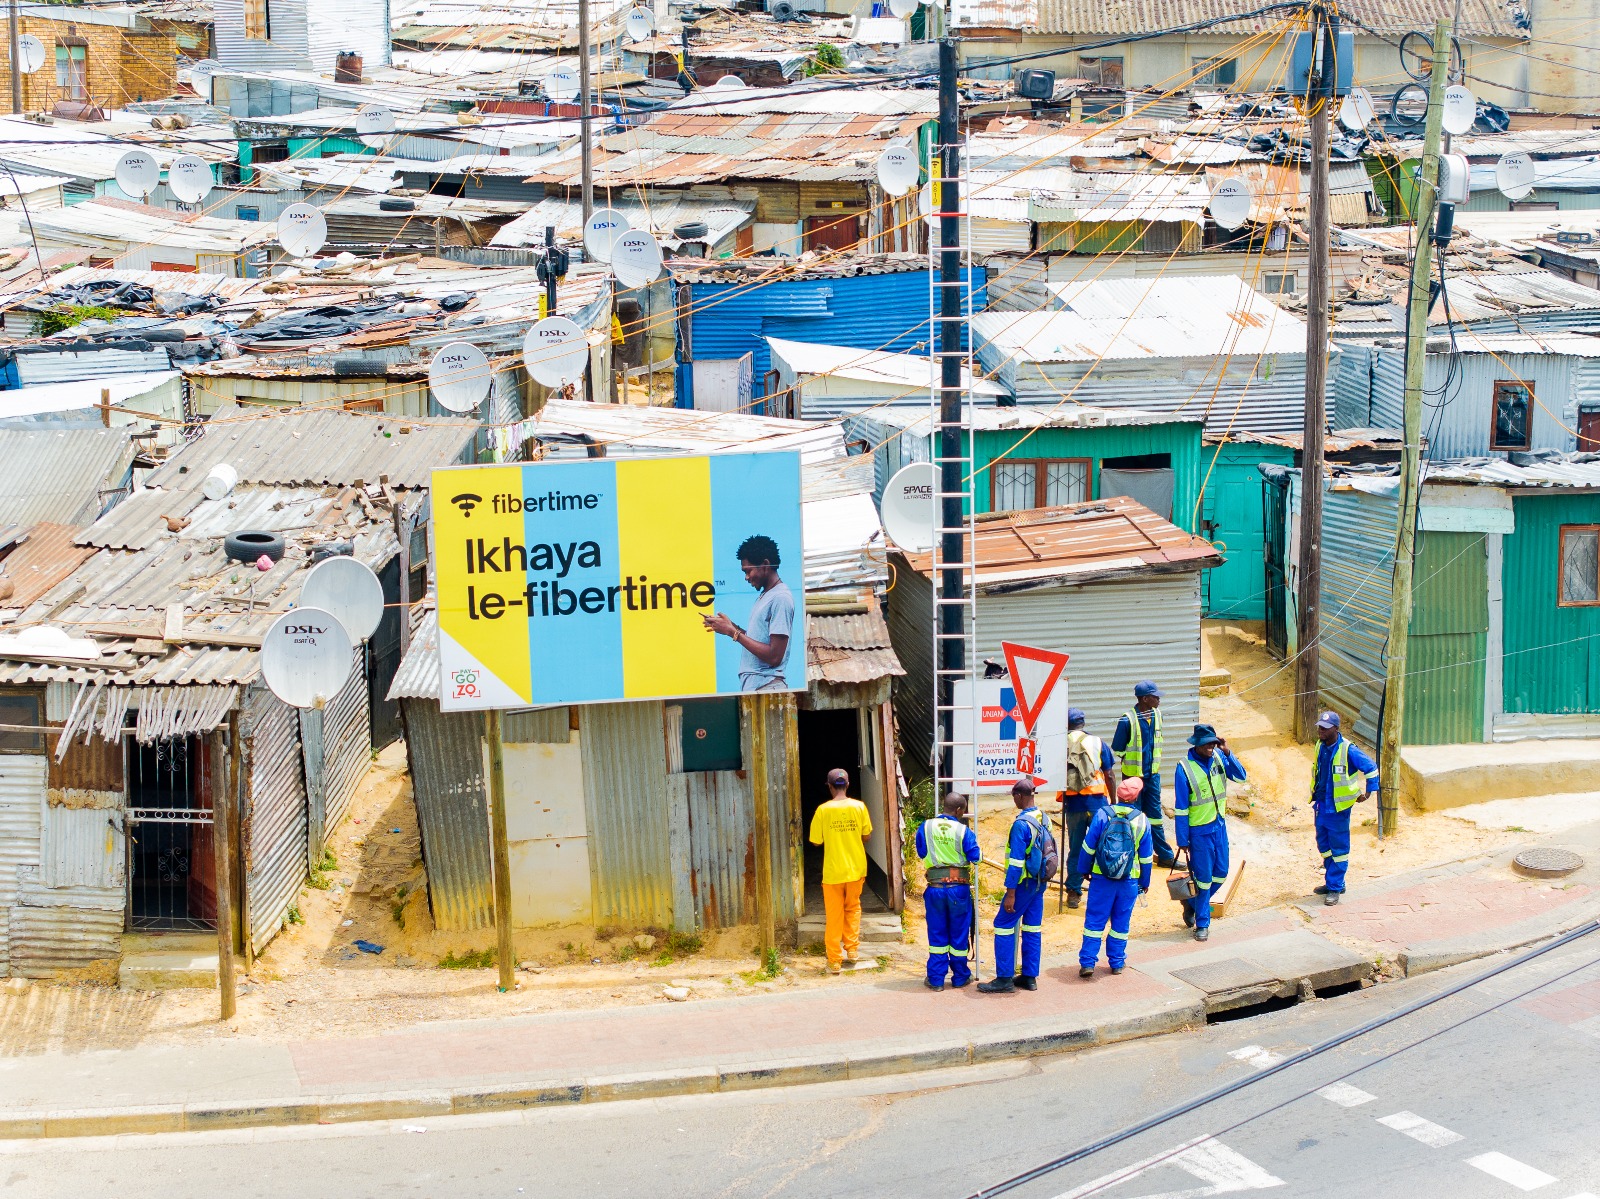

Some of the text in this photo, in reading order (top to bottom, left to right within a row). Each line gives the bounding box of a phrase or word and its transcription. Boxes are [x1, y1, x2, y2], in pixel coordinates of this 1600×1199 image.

[904, 486, 932, 494] SPACE
[466, 537, 601, 578] Ikhaya
[284, 626, 328, 634] DStv
[456, 674, 476, 684] GO
[456, 684, 476, 696] ZO
